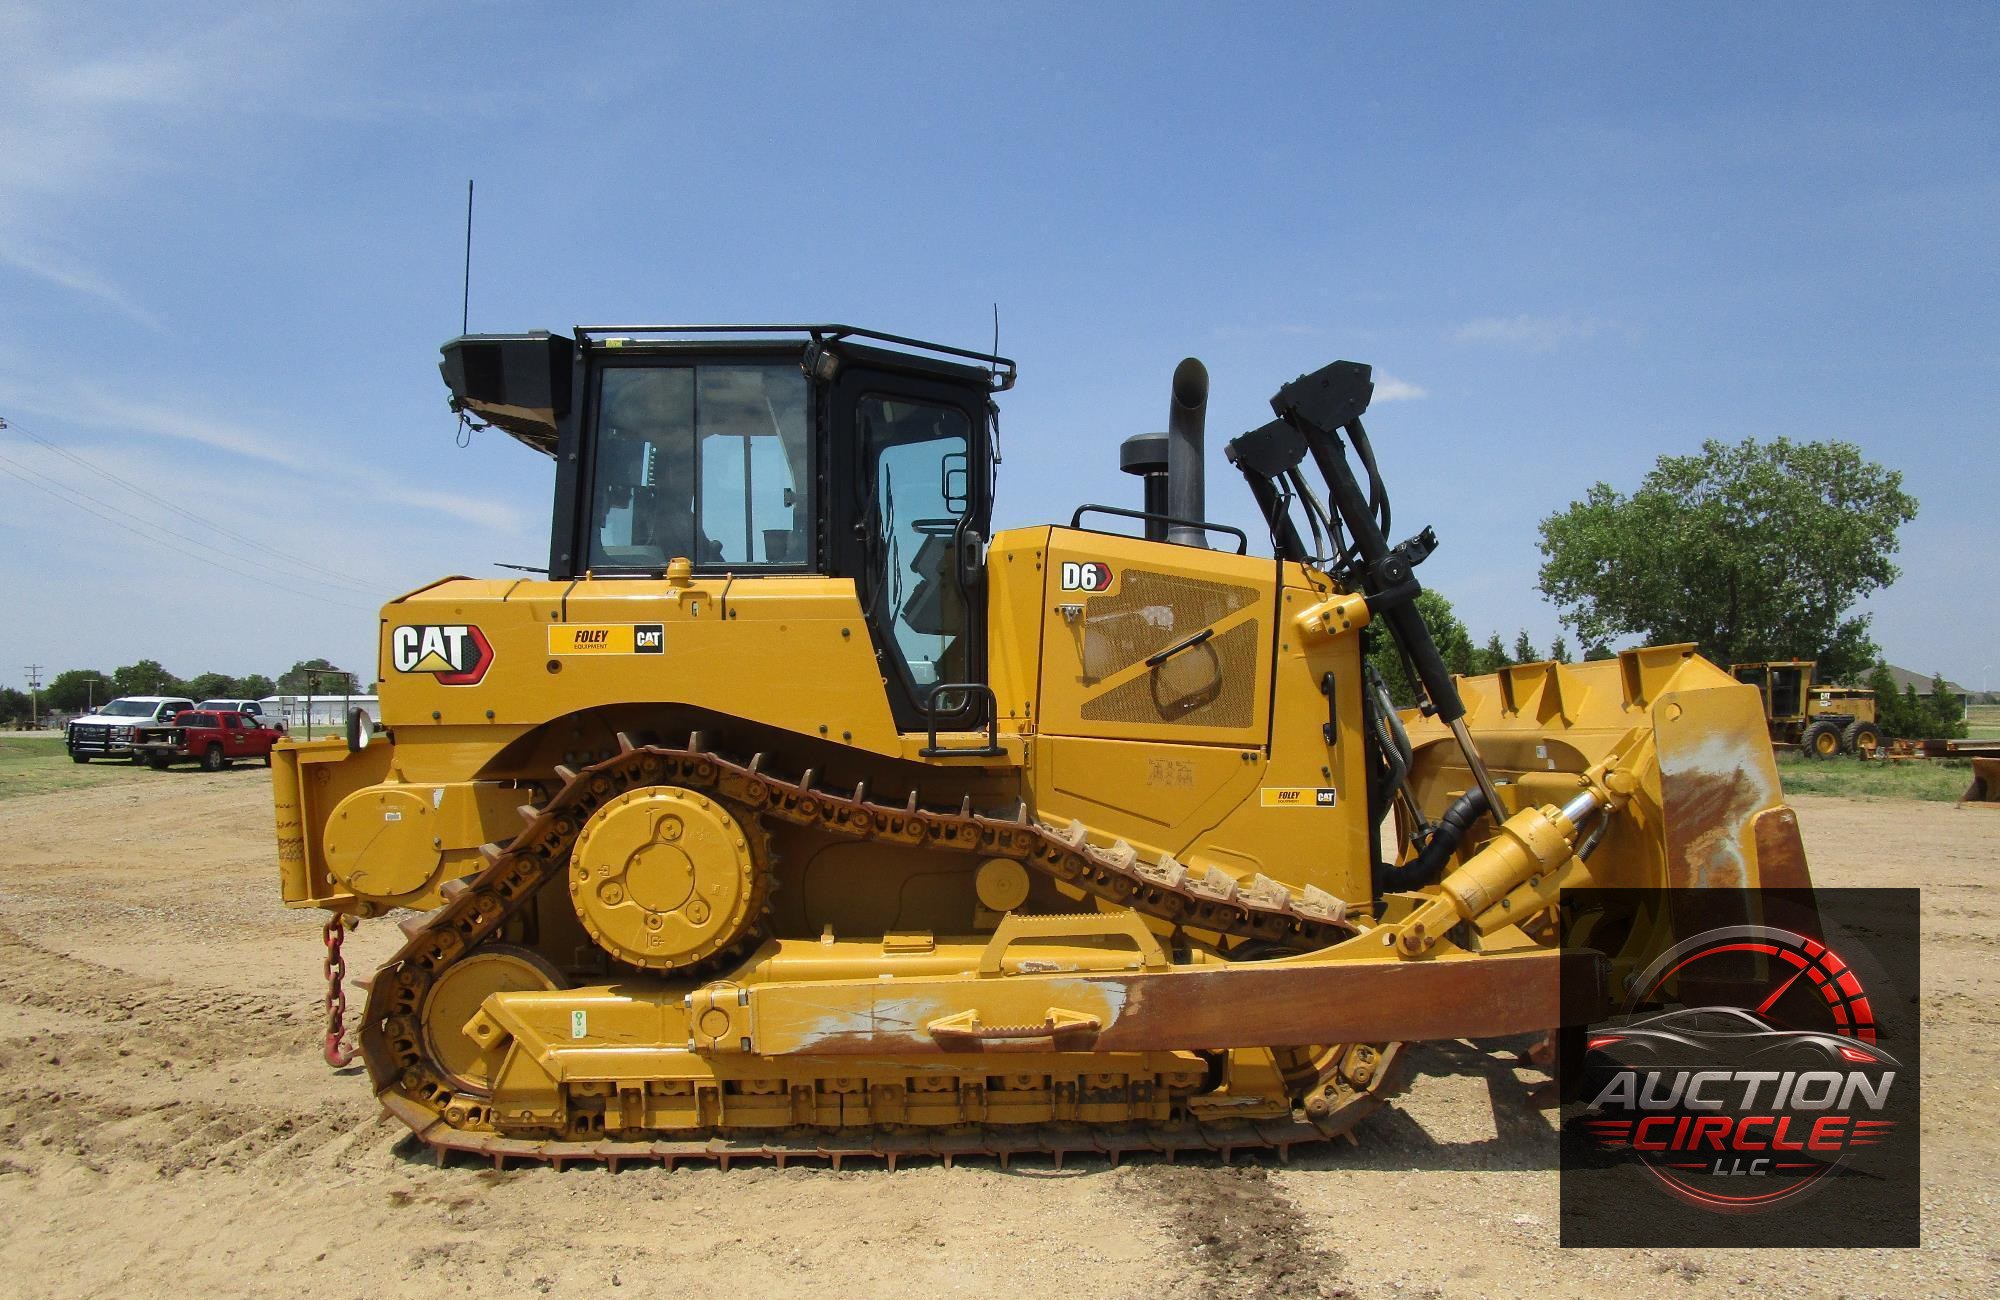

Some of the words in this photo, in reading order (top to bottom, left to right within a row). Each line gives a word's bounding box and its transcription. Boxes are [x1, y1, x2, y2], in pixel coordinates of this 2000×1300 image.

[1063, 562, 1097, 590] D6
[574, 630, 609, 643] FOLEY
[636, 631, 661, 647] CAT
[393, 625, 468, 672] CAT
[1279, 791, 1300, 799] FOLEY
[1318, 792, 1334, 802] CAT
